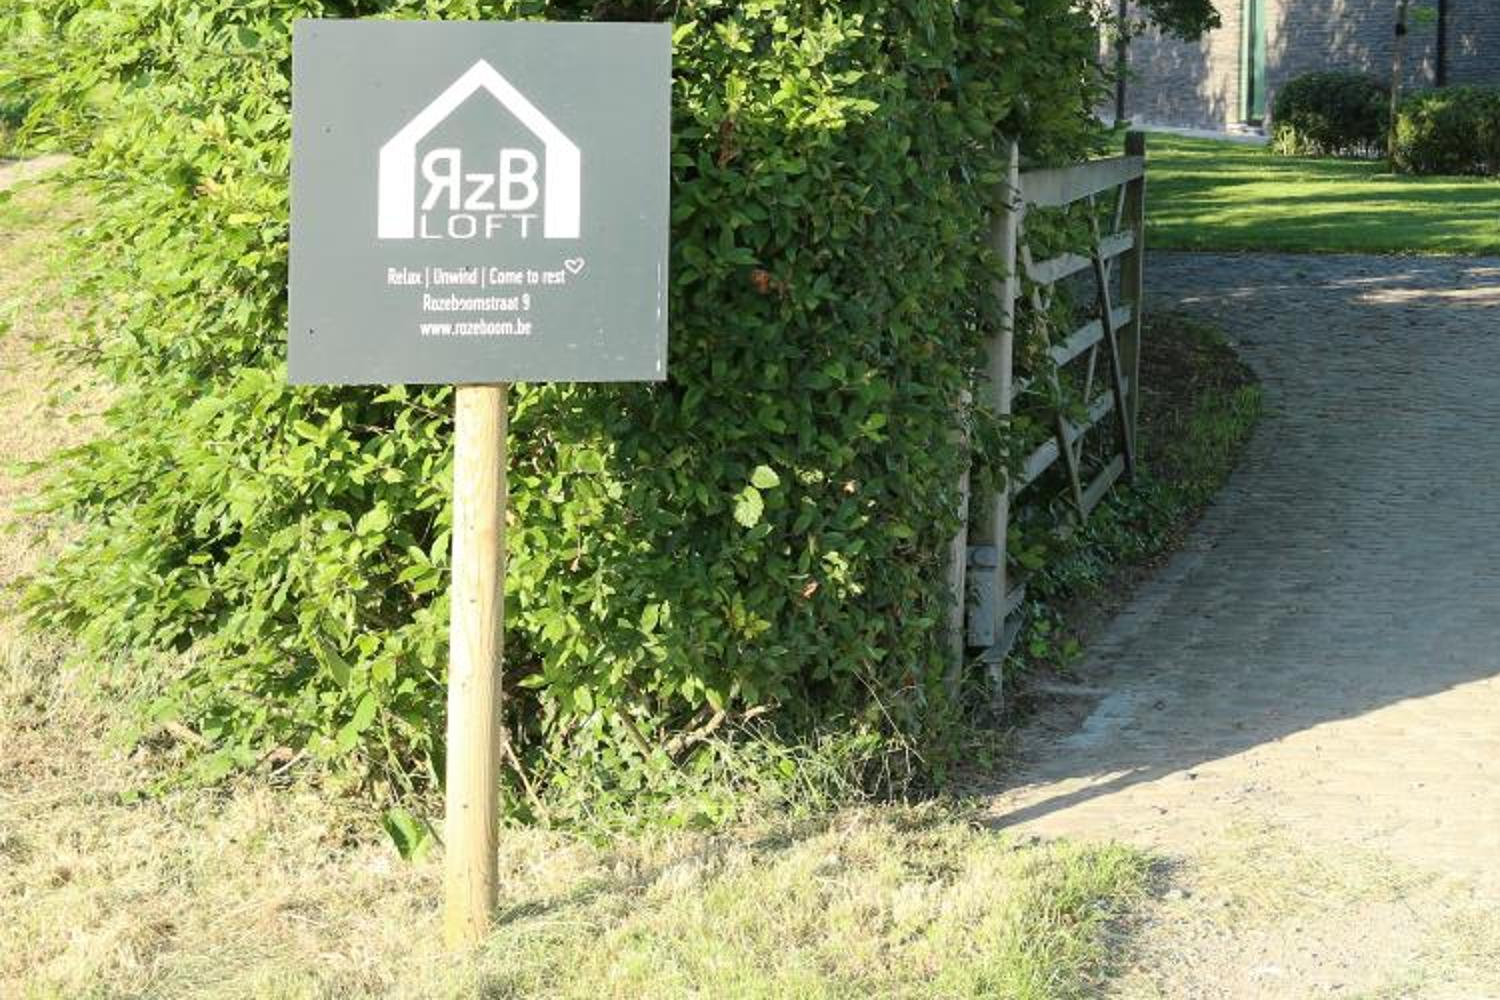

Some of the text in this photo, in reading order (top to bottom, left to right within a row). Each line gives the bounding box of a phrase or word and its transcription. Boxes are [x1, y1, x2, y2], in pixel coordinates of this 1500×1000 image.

[419, 213, 540, 240] LOFT
[387, 267, 423, 285] Relax
[433, 267, 478, 285] Unwind
[489, 267, 524, 285] Come
[526, 269, 539, 285] to
[541, 269, 566, 285] rest
[422, 293, 531, 312] Rozeboomstraat 9
[419, 317, 533, 337] www.rozeboom.be
